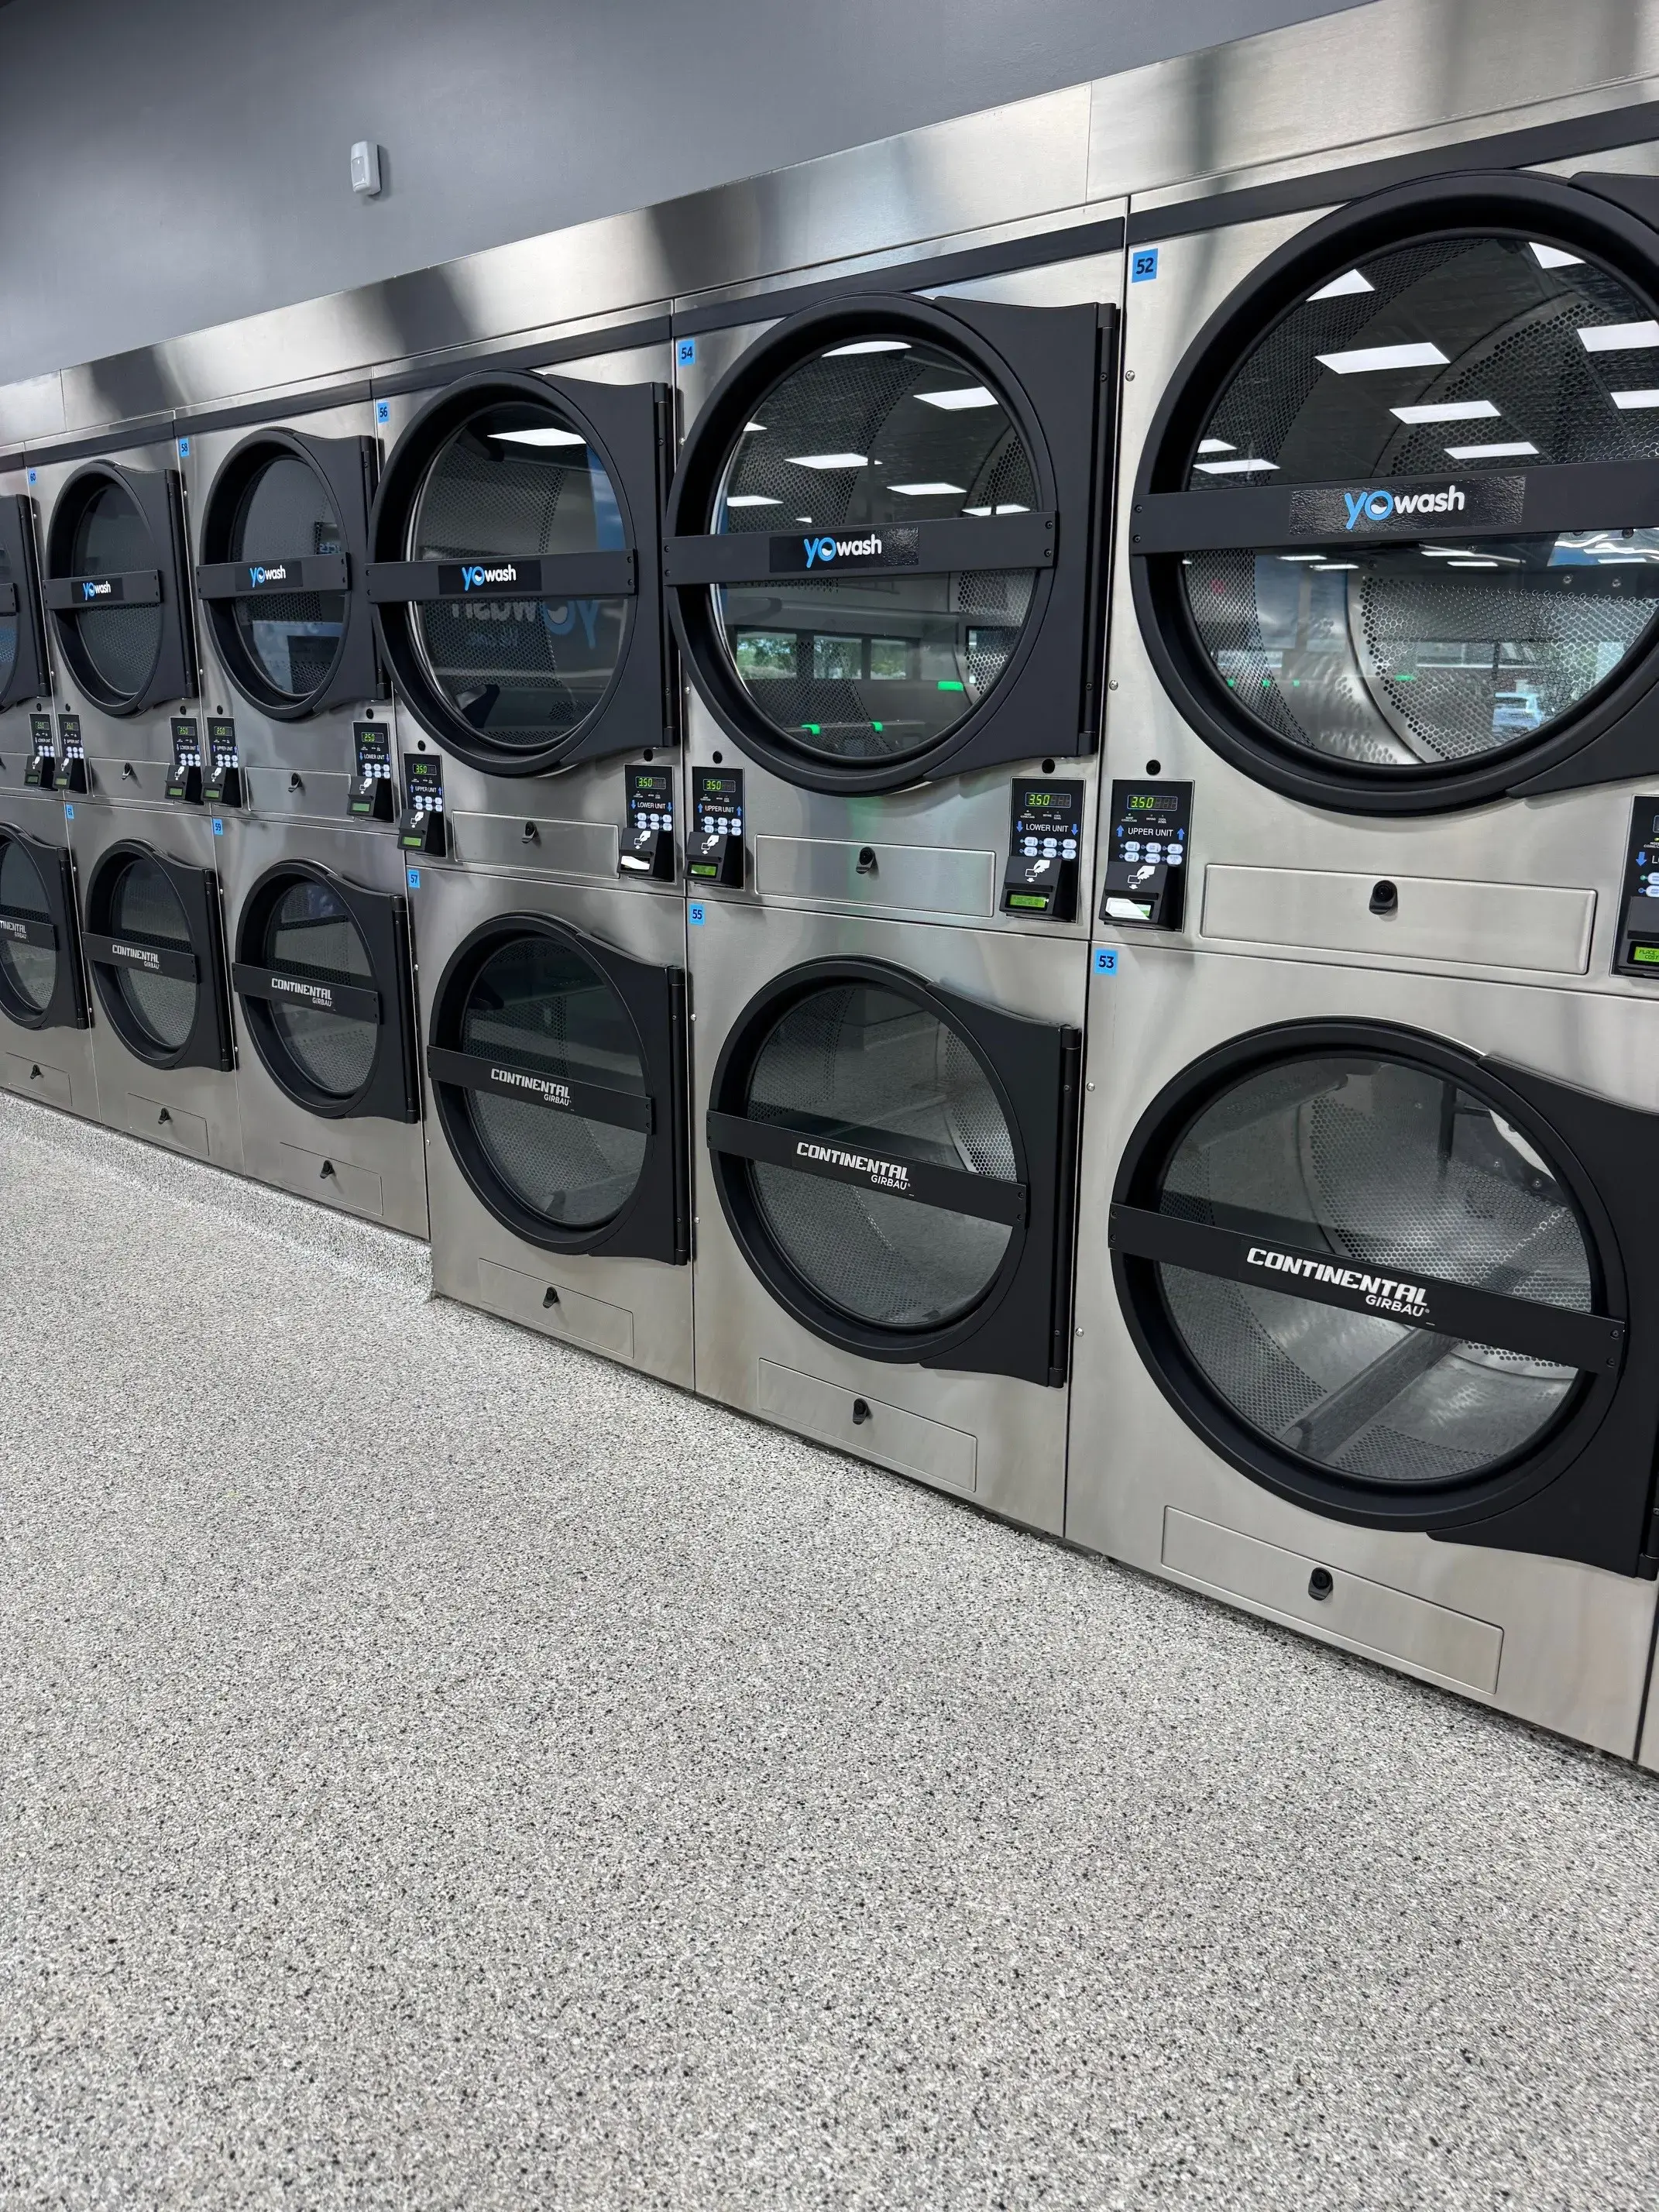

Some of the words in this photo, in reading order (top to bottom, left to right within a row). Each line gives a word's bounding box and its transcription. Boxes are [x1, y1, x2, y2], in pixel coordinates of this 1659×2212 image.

[1136, 257, 1154, 275] 52
[681, 346, 693, 359] 54
[380, 407, 387, 417] 56
[181, 443, 188, 452] 58
[1345, 485, 1465, 530] yowash
[804, 534, 882, 568] yowash
[249, 565, 286, 589] yowash
[462, 564, 517, 591] yowash
[82, 580, 112, 601] yowash
[1025, 823, 1051, 832] LOWER
[1128, 827, 1154, 836] UPPER
[410, 874, 417, 883] 57
[692, 908, 702, 920] 55
[112, 944, 160, 963] CONTINENTAL
[1098, 955, 1115, 969] 53
[270, 977, 332, 1000] CONTINENTAL
[490, 1068, 570, 1099] CONTINENTAL
[796, 1142, 909, 1182] CONTINENTAL
[1246, 1247, 1428, 1307] CONTINENTAL
